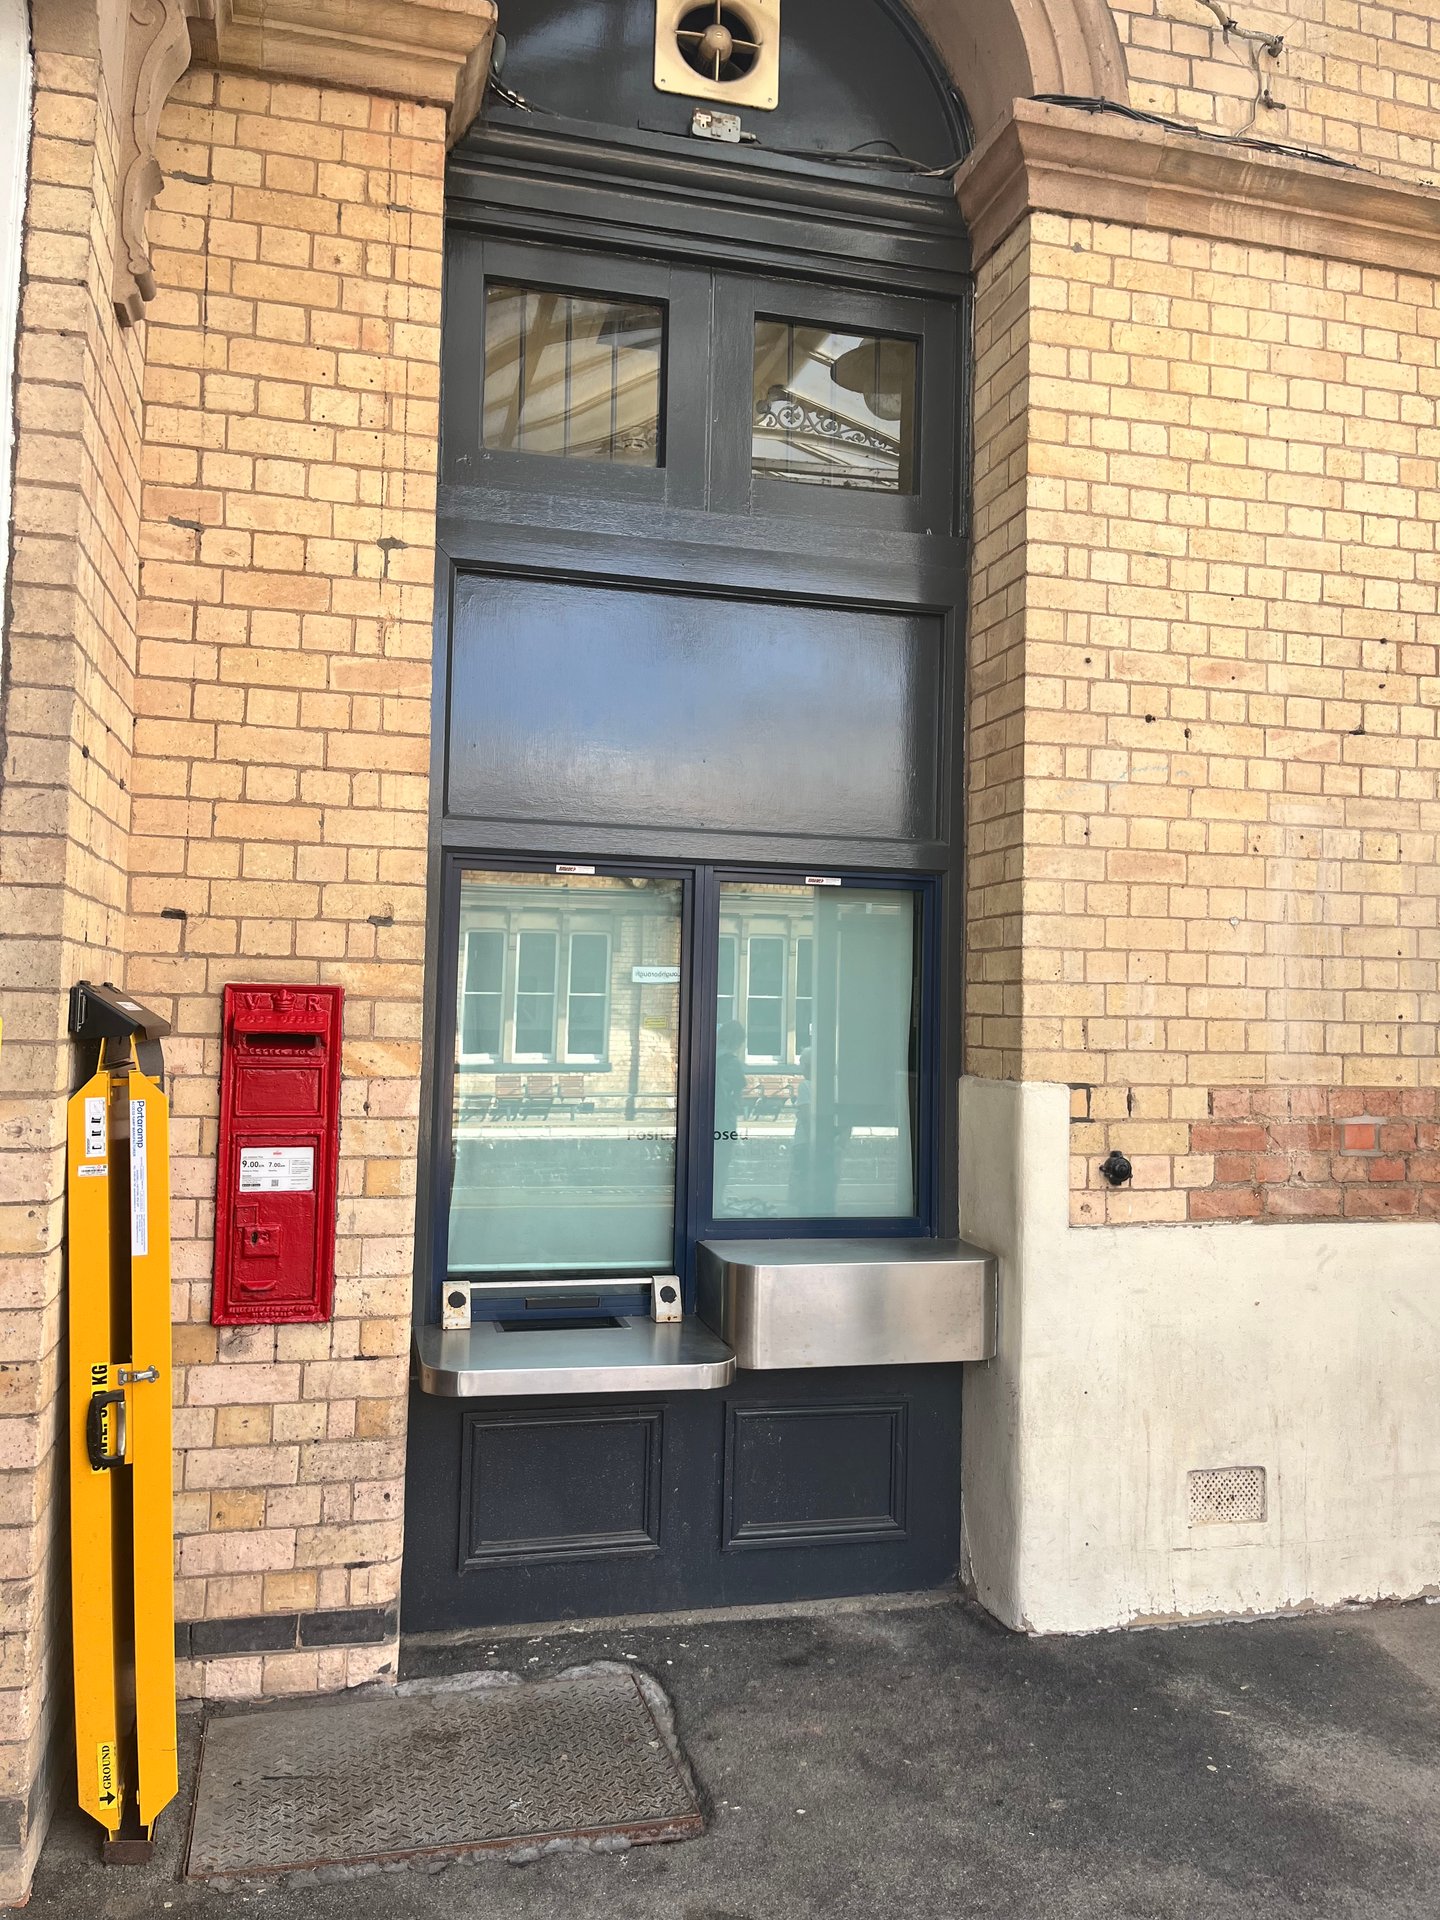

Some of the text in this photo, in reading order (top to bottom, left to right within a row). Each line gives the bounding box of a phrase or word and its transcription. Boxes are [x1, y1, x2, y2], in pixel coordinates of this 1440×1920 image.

[244, 994, 321, 1011] V R
[136, 1101, 144, 1148] Portaramp
[714, 1129, 749, 1141] osed
[92, 1365, 108, 1386] KG
[102, 1745, 112, 1790] GROUND
